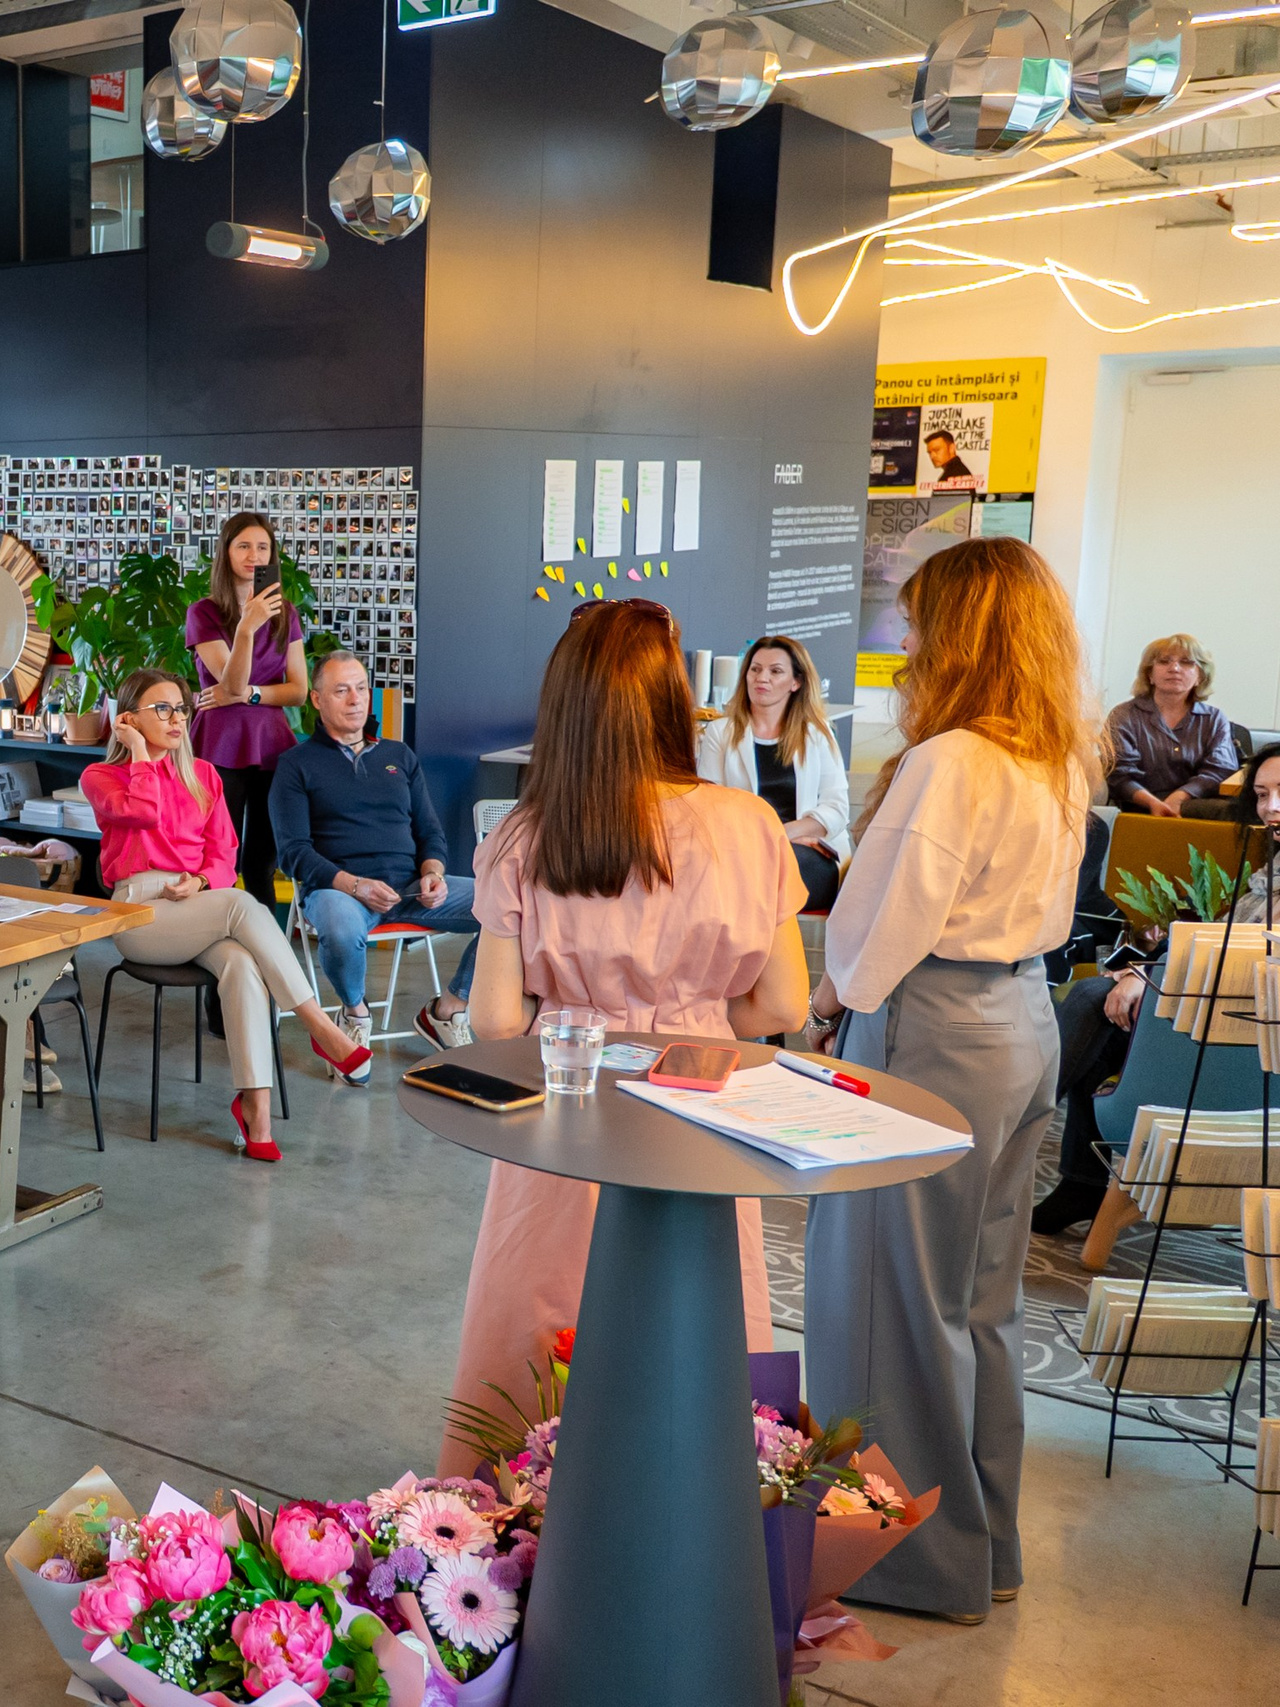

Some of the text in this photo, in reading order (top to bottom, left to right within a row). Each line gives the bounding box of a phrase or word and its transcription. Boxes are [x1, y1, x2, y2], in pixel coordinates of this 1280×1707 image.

[875, 371, 1020, 389] Panou cu întâmplări și
[928, 393, 948, 404] din
[928, 408, 962, 420] JUSTIN
[955, 431, 985, 441] AT THE
[956, 440, 990, 451] CASTLE
